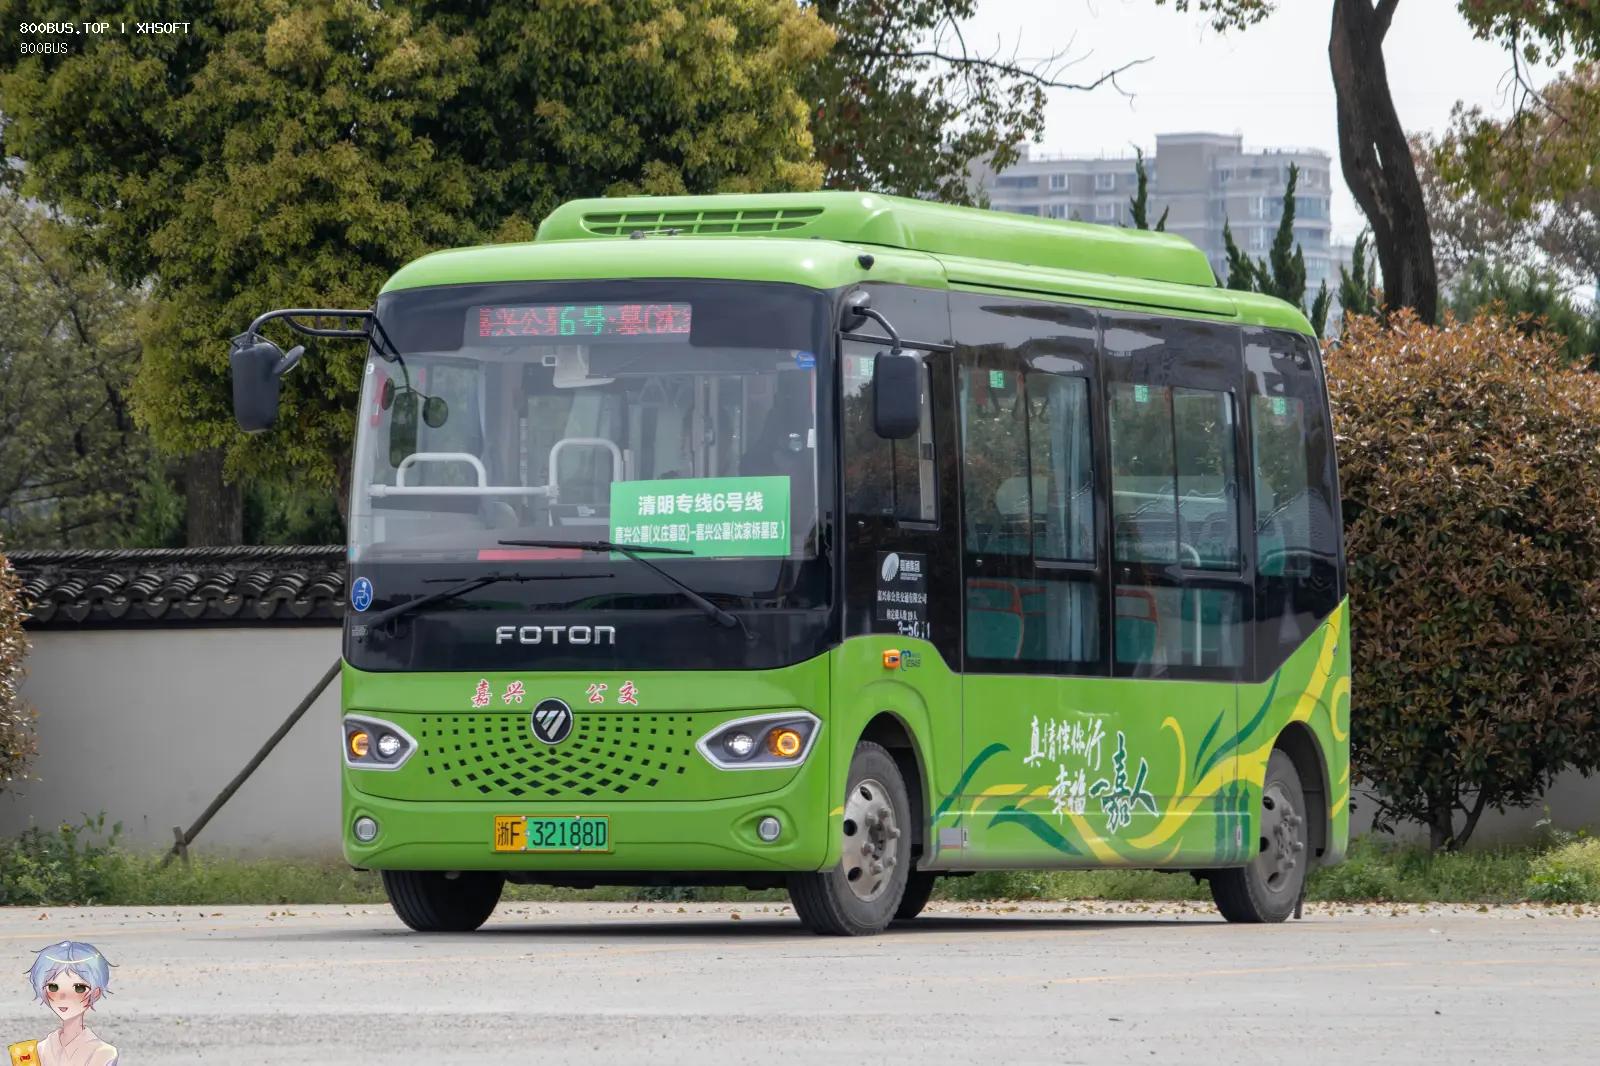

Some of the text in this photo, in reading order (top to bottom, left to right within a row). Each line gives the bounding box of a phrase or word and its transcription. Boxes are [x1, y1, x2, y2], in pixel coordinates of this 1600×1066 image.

[638, 491, 764, 516] 清明专线6号线
[495, 625, 616, 645] FOTON
[471, 679, 639, 708] 嘉兴 公交
[497, 821, 607, 847] 浙F 32188D
